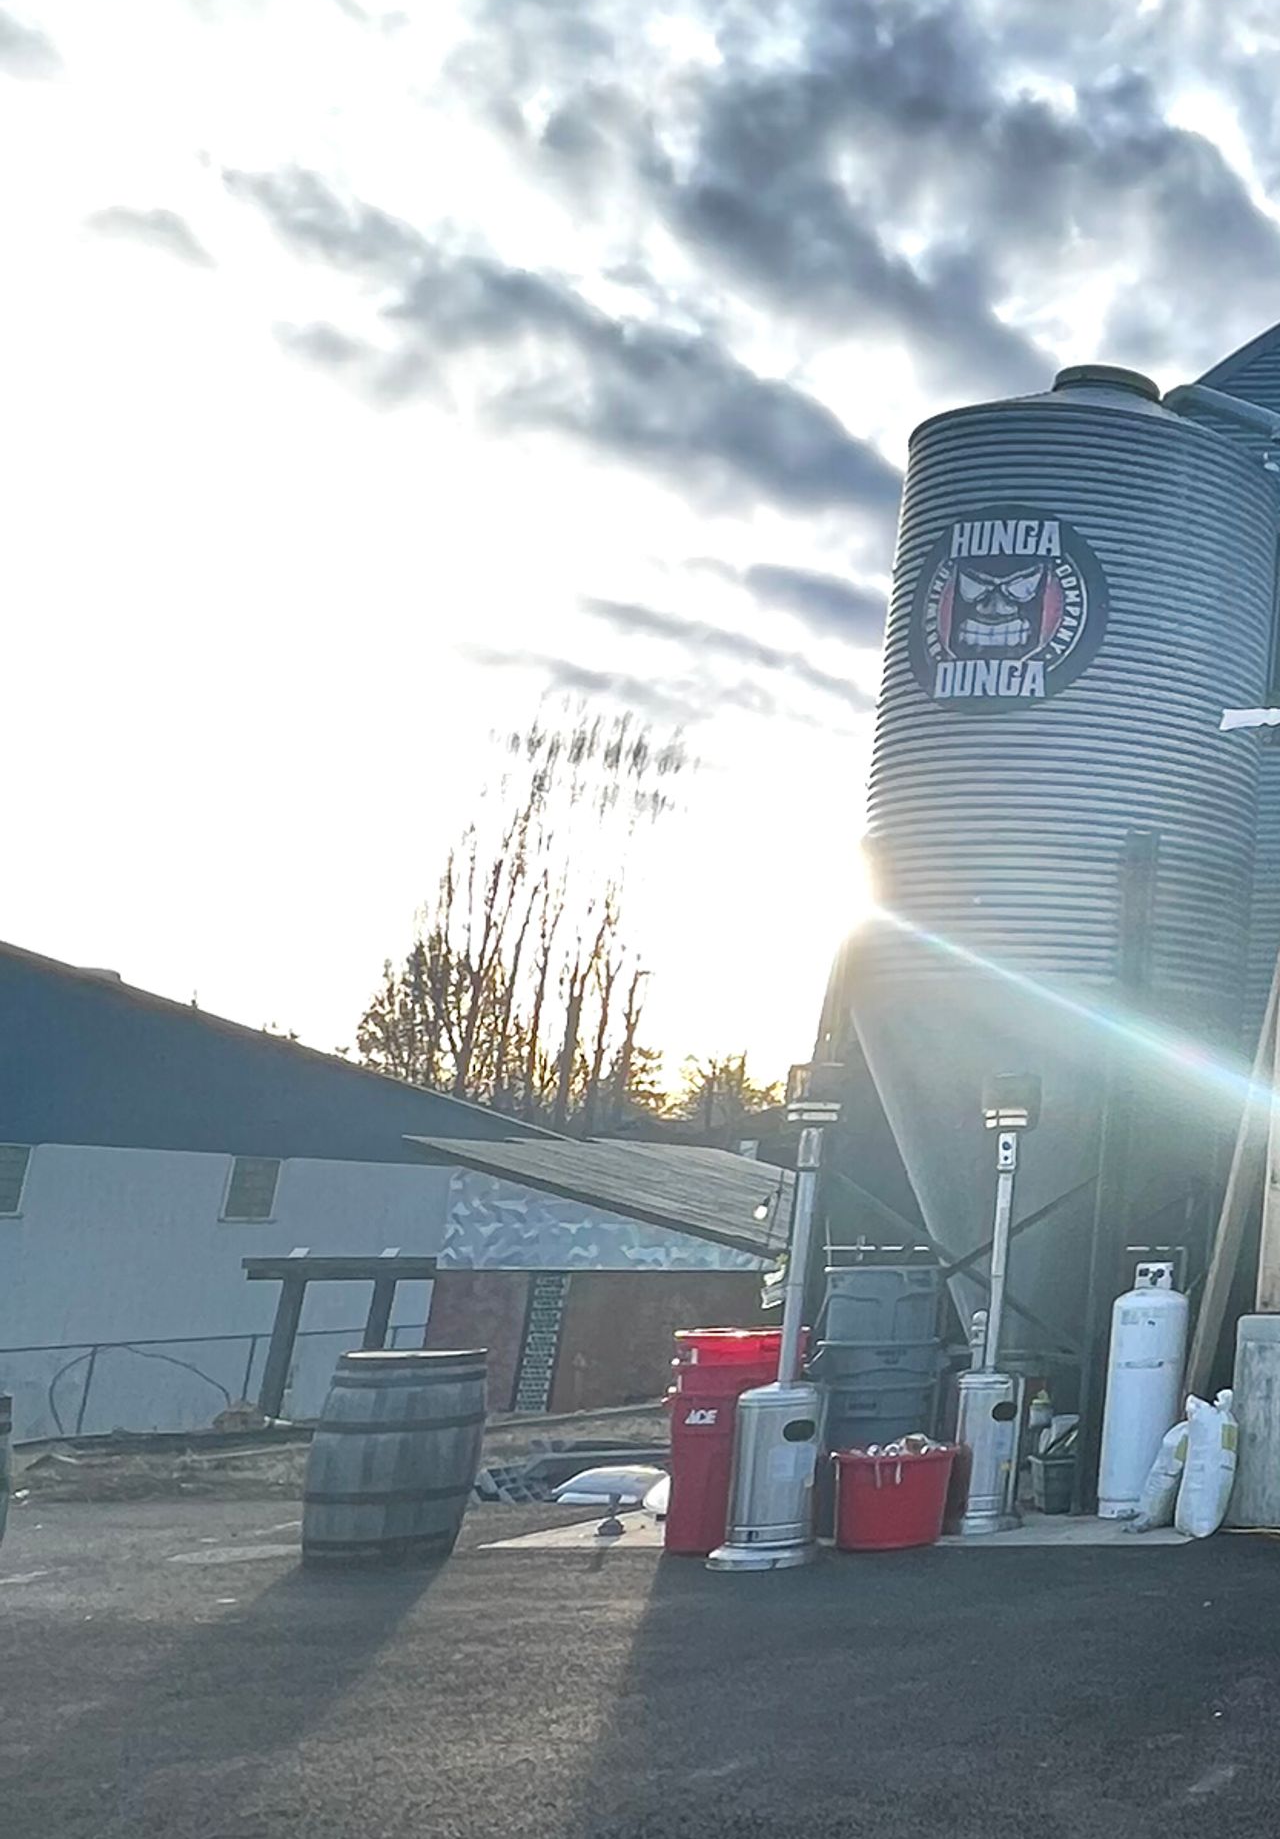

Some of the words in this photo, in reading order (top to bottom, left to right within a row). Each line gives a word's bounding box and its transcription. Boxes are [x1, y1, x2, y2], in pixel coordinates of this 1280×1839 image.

[950, 519, 1062, 559] HUNGA
[1050, 563, 1082, 656] COMPANY
[933, 659, 1046, 699] DUNGA
